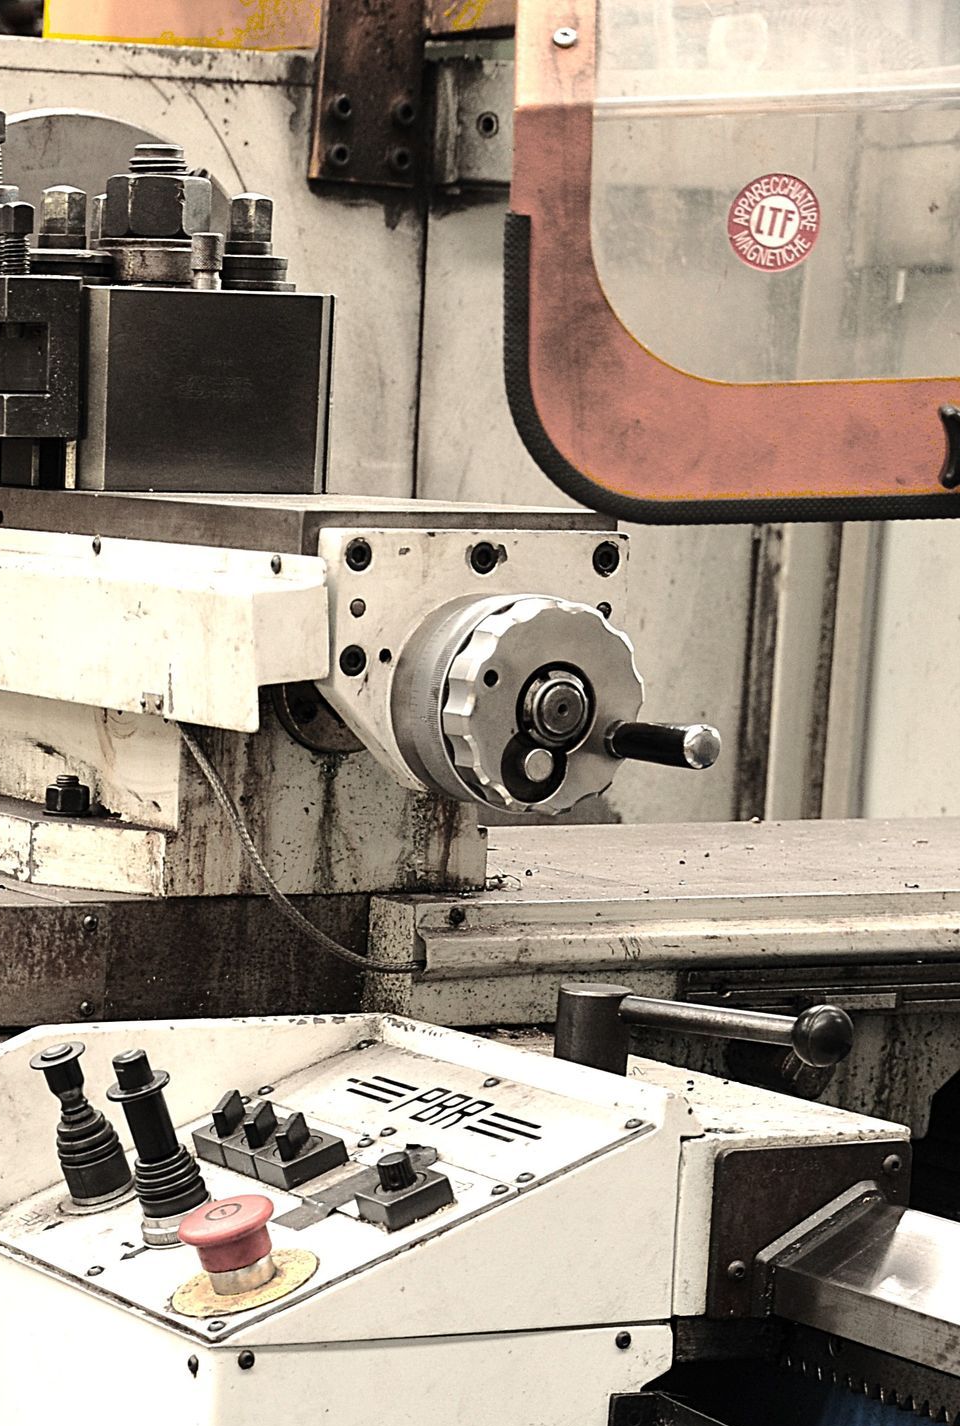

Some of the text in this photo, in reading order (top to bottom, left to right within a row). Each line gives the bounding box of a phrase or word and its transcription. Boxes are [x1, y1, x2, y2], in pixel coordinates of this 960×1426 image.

[733, 176, 818, 232] APPARECCHIATURE
[754, 204, 796, 239] LTF
[732, 229, 811, 267] MAGNETICHE
[388, 1086, 496, 1130] PBR
